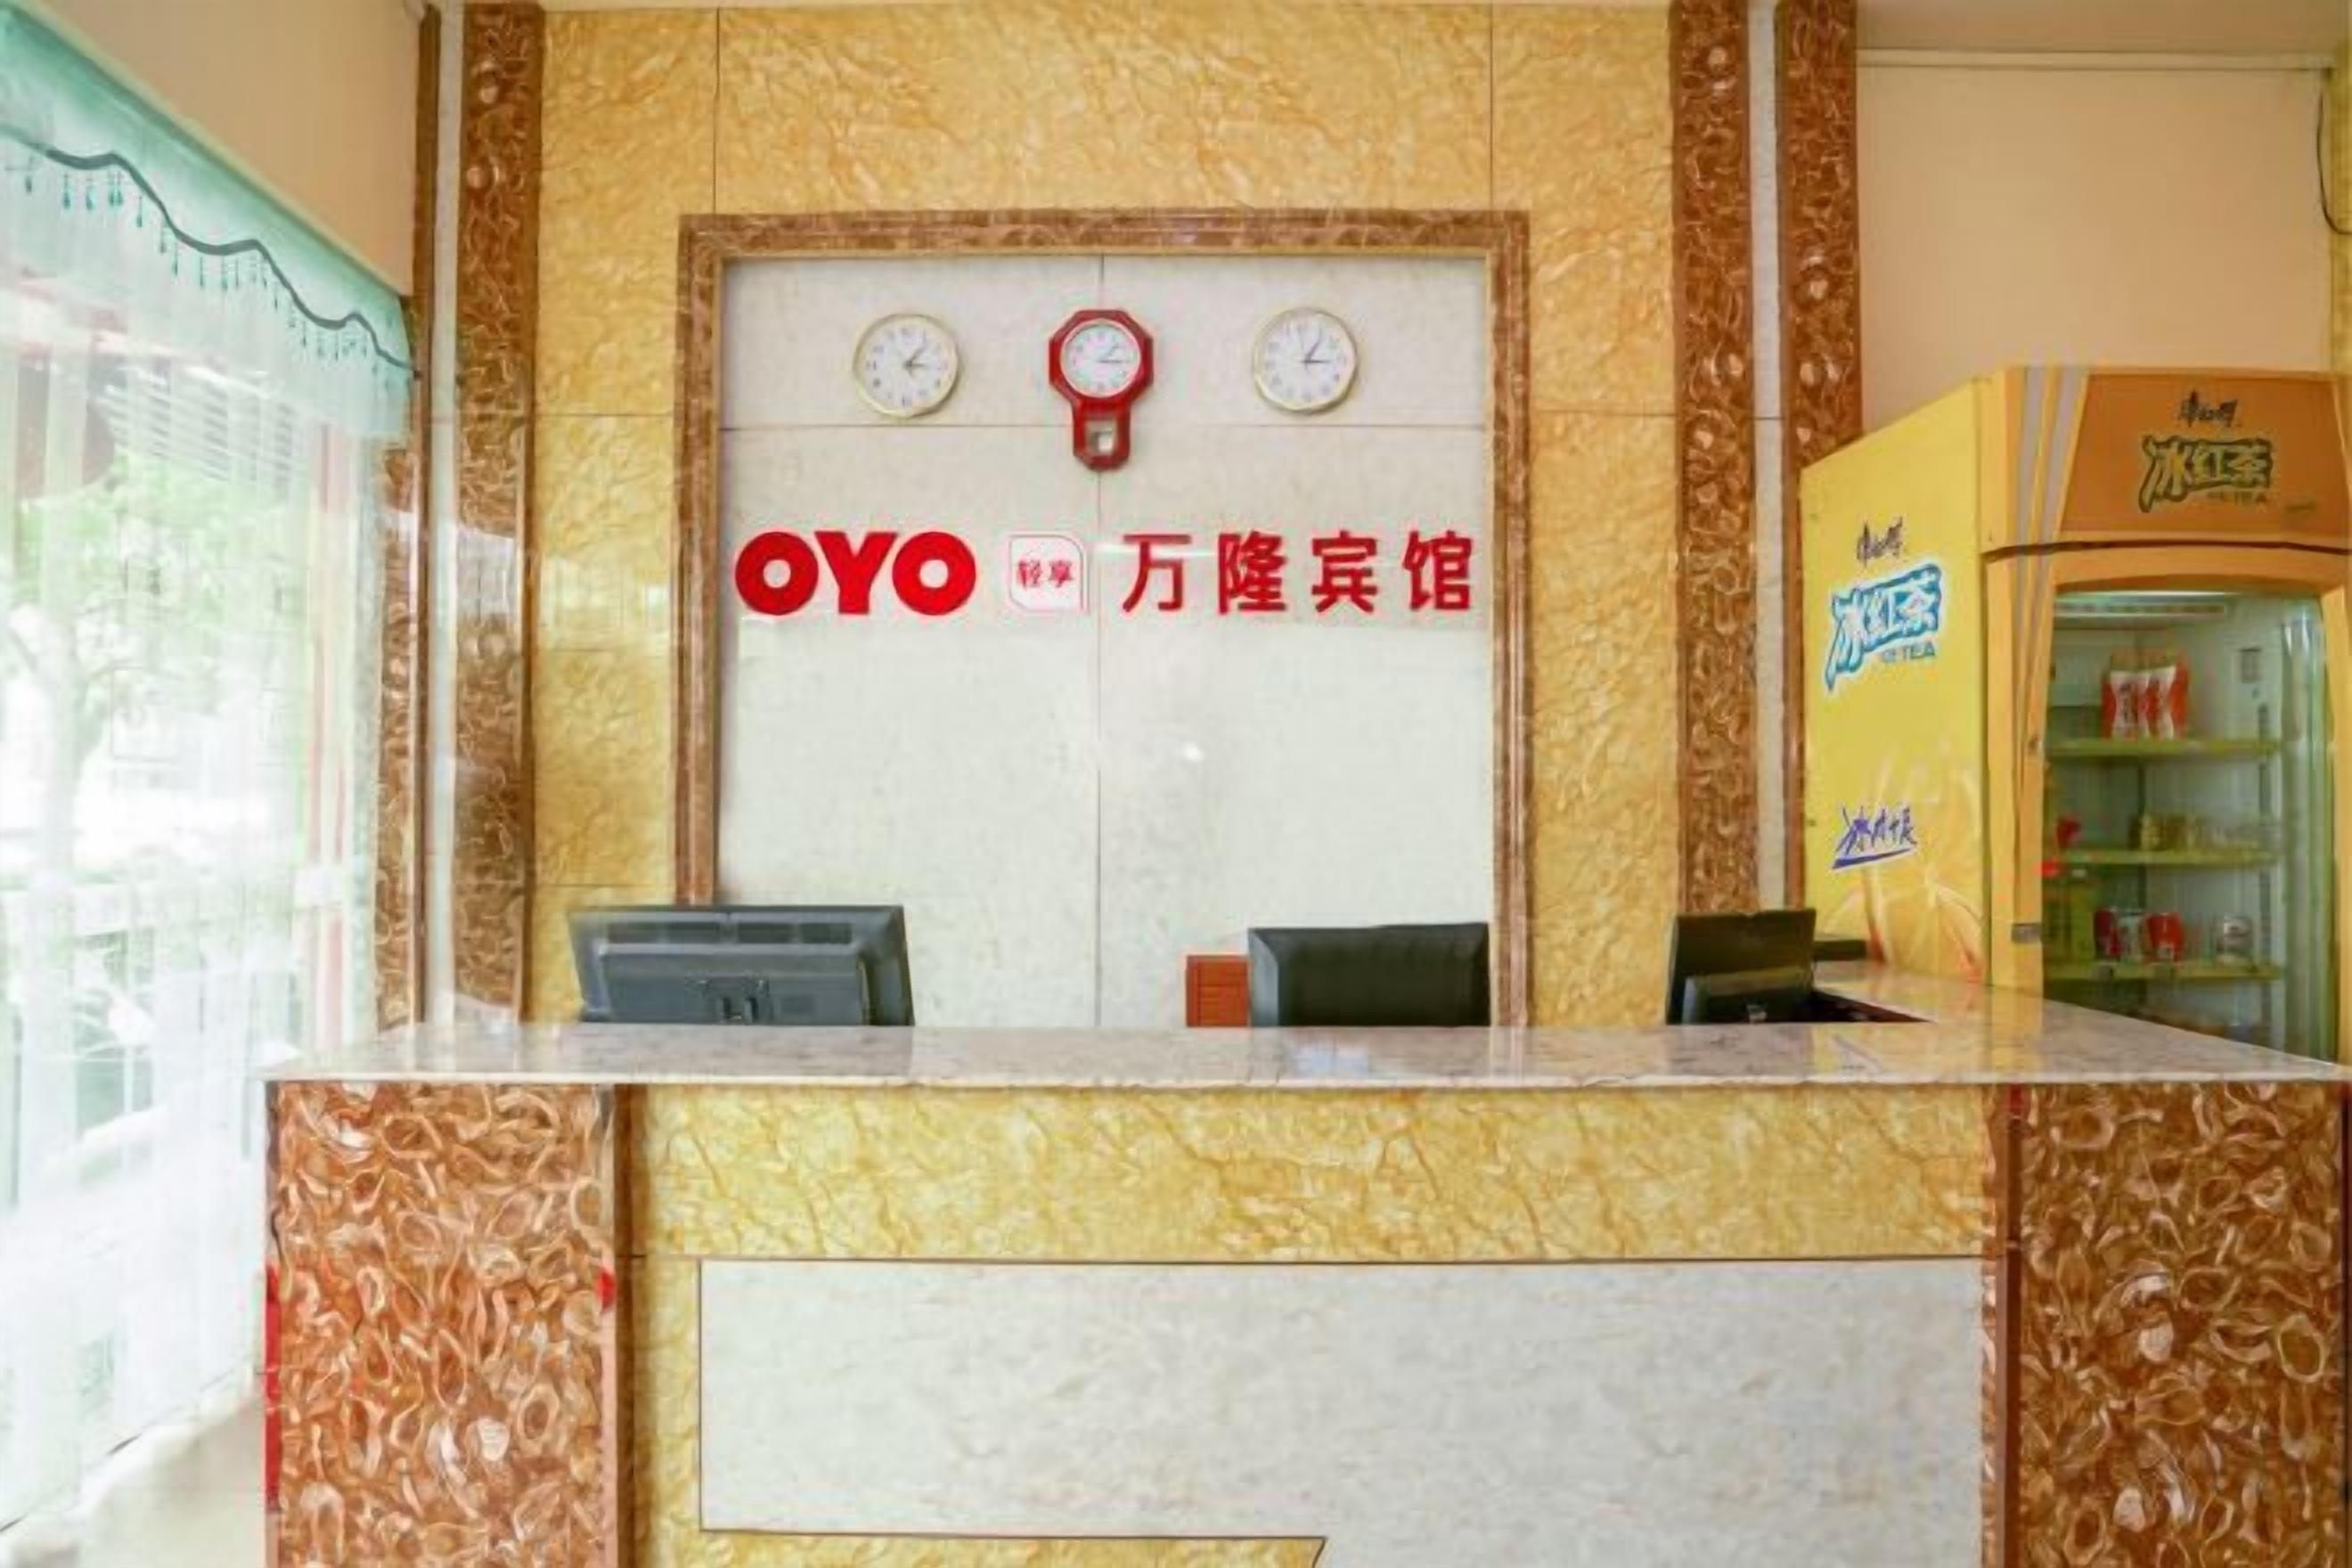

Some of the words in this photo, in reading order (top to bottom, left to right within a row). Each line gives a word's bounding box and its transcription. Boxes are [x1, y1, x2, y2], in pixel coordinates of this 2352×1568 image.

[733, 529, 977, 617] OYO
[1121, 527, 1474, 615] 万隆宾馆
